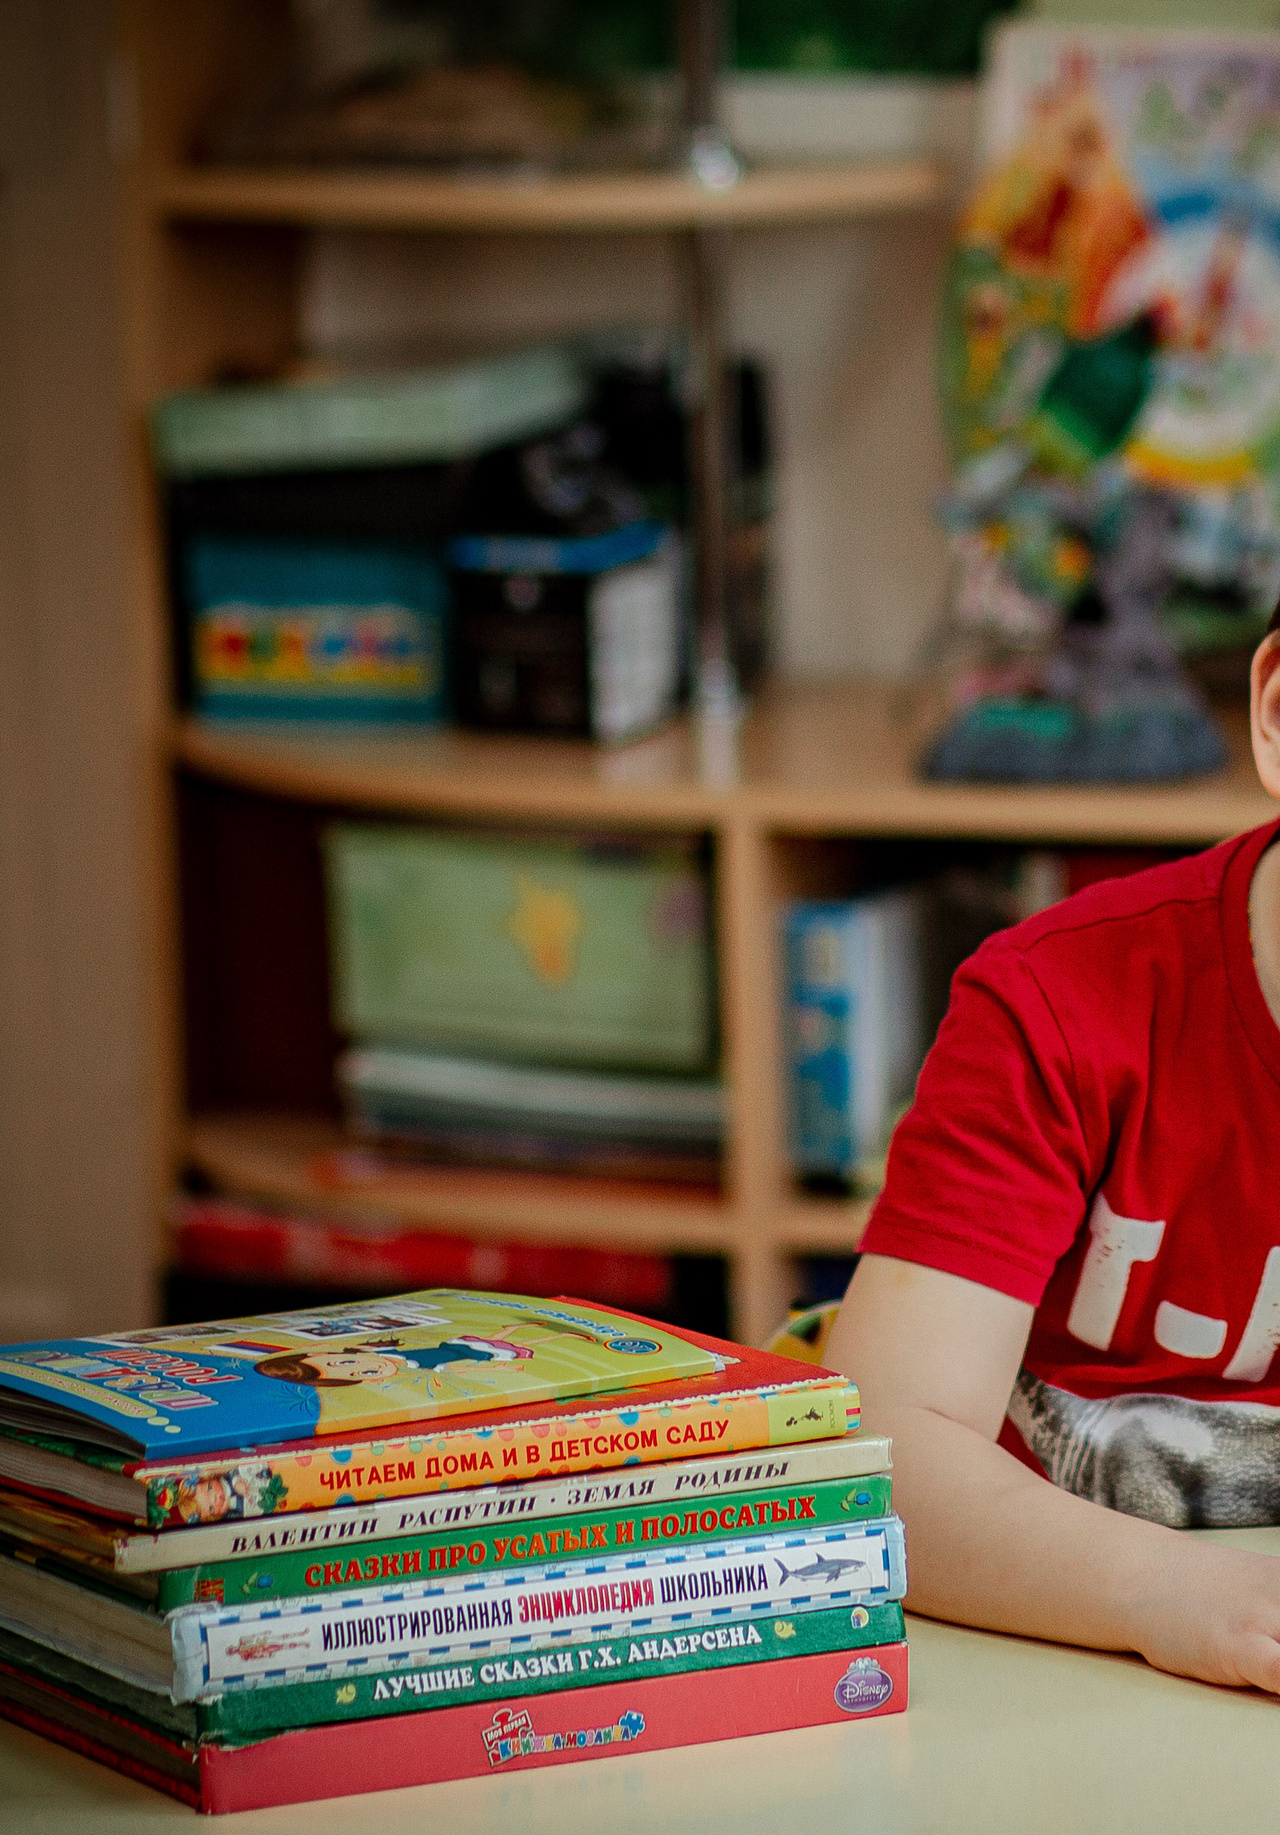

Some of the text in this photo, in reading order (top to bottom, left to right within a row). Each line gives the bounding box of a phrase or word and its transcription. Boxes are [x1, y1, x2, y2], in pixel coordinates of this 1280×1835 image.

[319, 1419, 730, 1491] ЧИТАЕМ ДОМА И В ДЕТСКОМ САДУ
[231, 1461, 790, 1553] ВАЛЕНТИН РАСПУТИН ЗЕМЛЯ РОДИНЫ
[304, 1495, 817, 1588] СКАЗКИ ПРО УСАТЫХ И ПОЛОСАТЫХ
[321, 1563, 769, 1651] ИЛЛЮСТРИРОВАННАЯ ЭНЦИКЛОПЕДИЯ ШКОЛЬНИКА
[373, 1624, 763, 1701] ЛУЧШИЕ СКАЗКИ Г.Х. АНДЕРСЕНА
[487, 1715, 527, 1741] МОЯ ПЕРВАЯ
